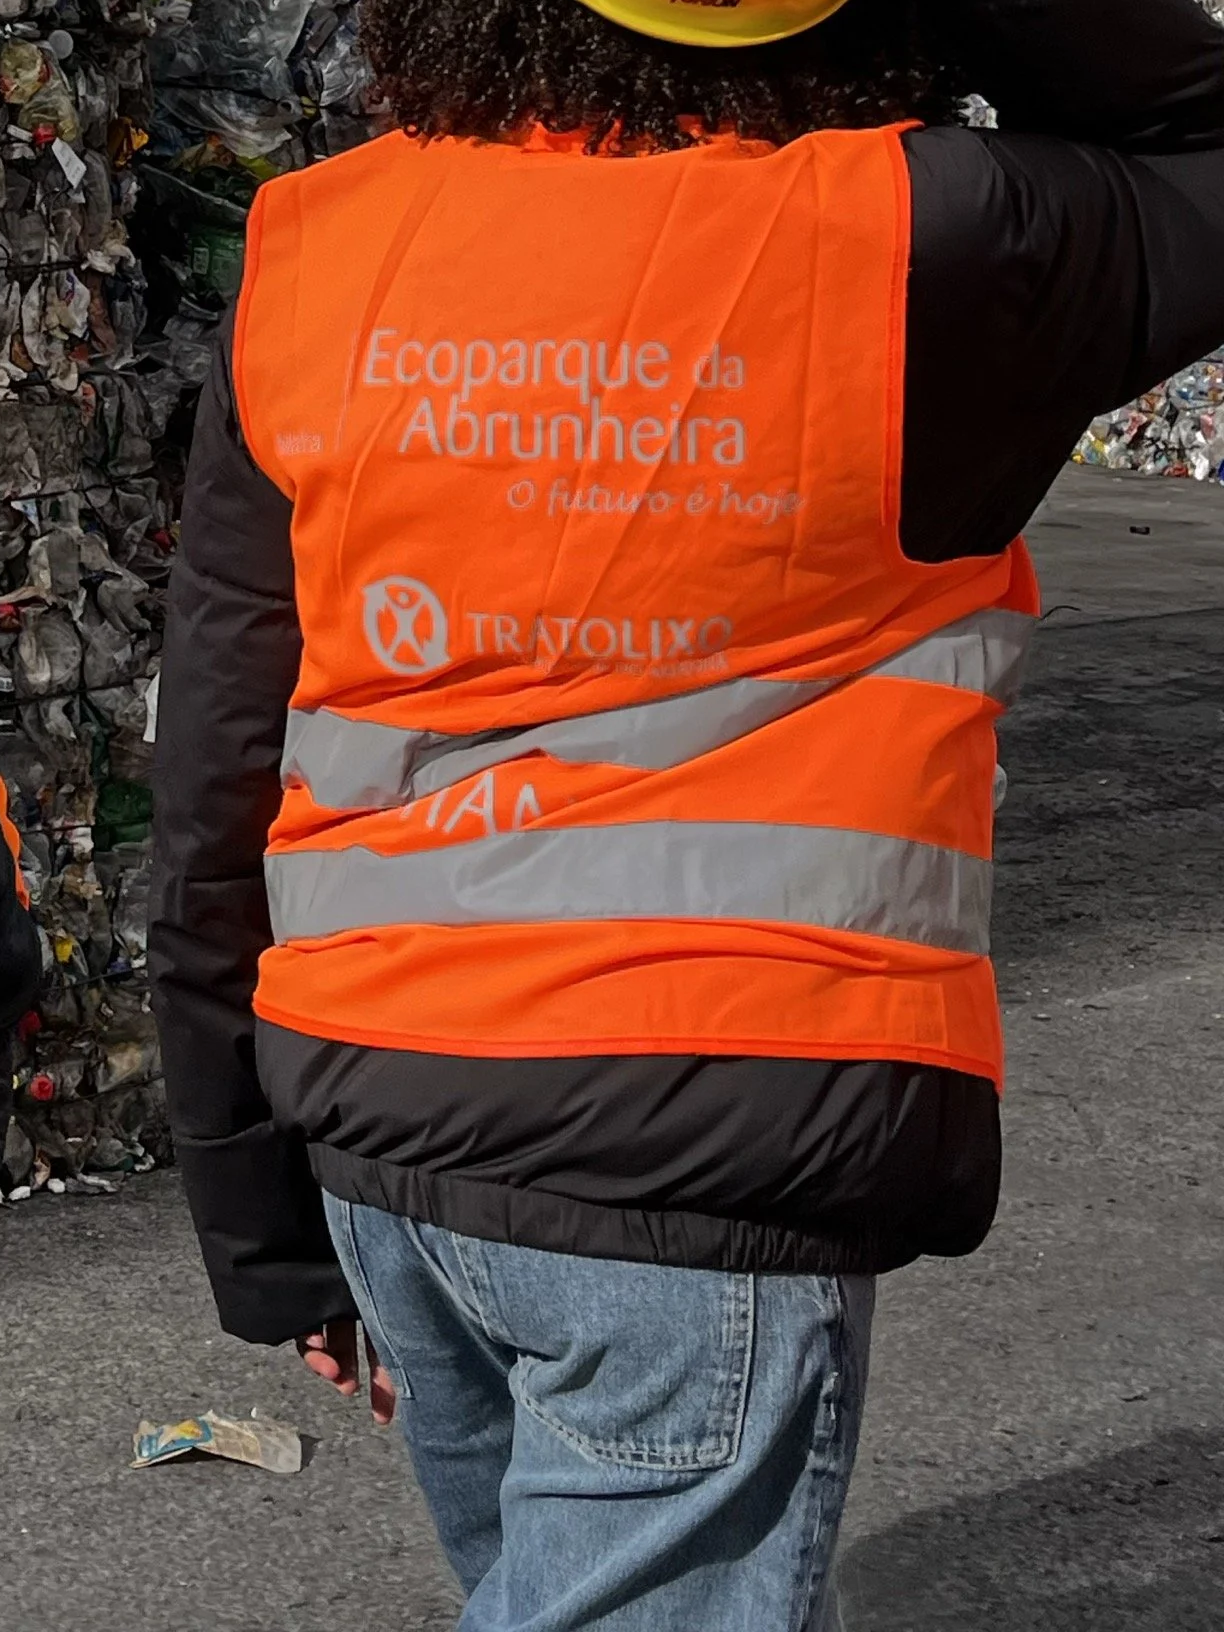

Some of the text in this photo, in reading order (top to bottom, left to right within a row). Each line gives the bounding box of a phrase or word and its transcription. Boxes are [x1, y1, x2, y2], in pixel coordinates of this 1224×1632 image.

[362, 328, 746, 406] Ecoparque da
[398, 393, 747, 467] Abrunheira
[506, 476, 805, 526] O futuro é hoje
[465, 611, 733, 660] TRATOLIXO
